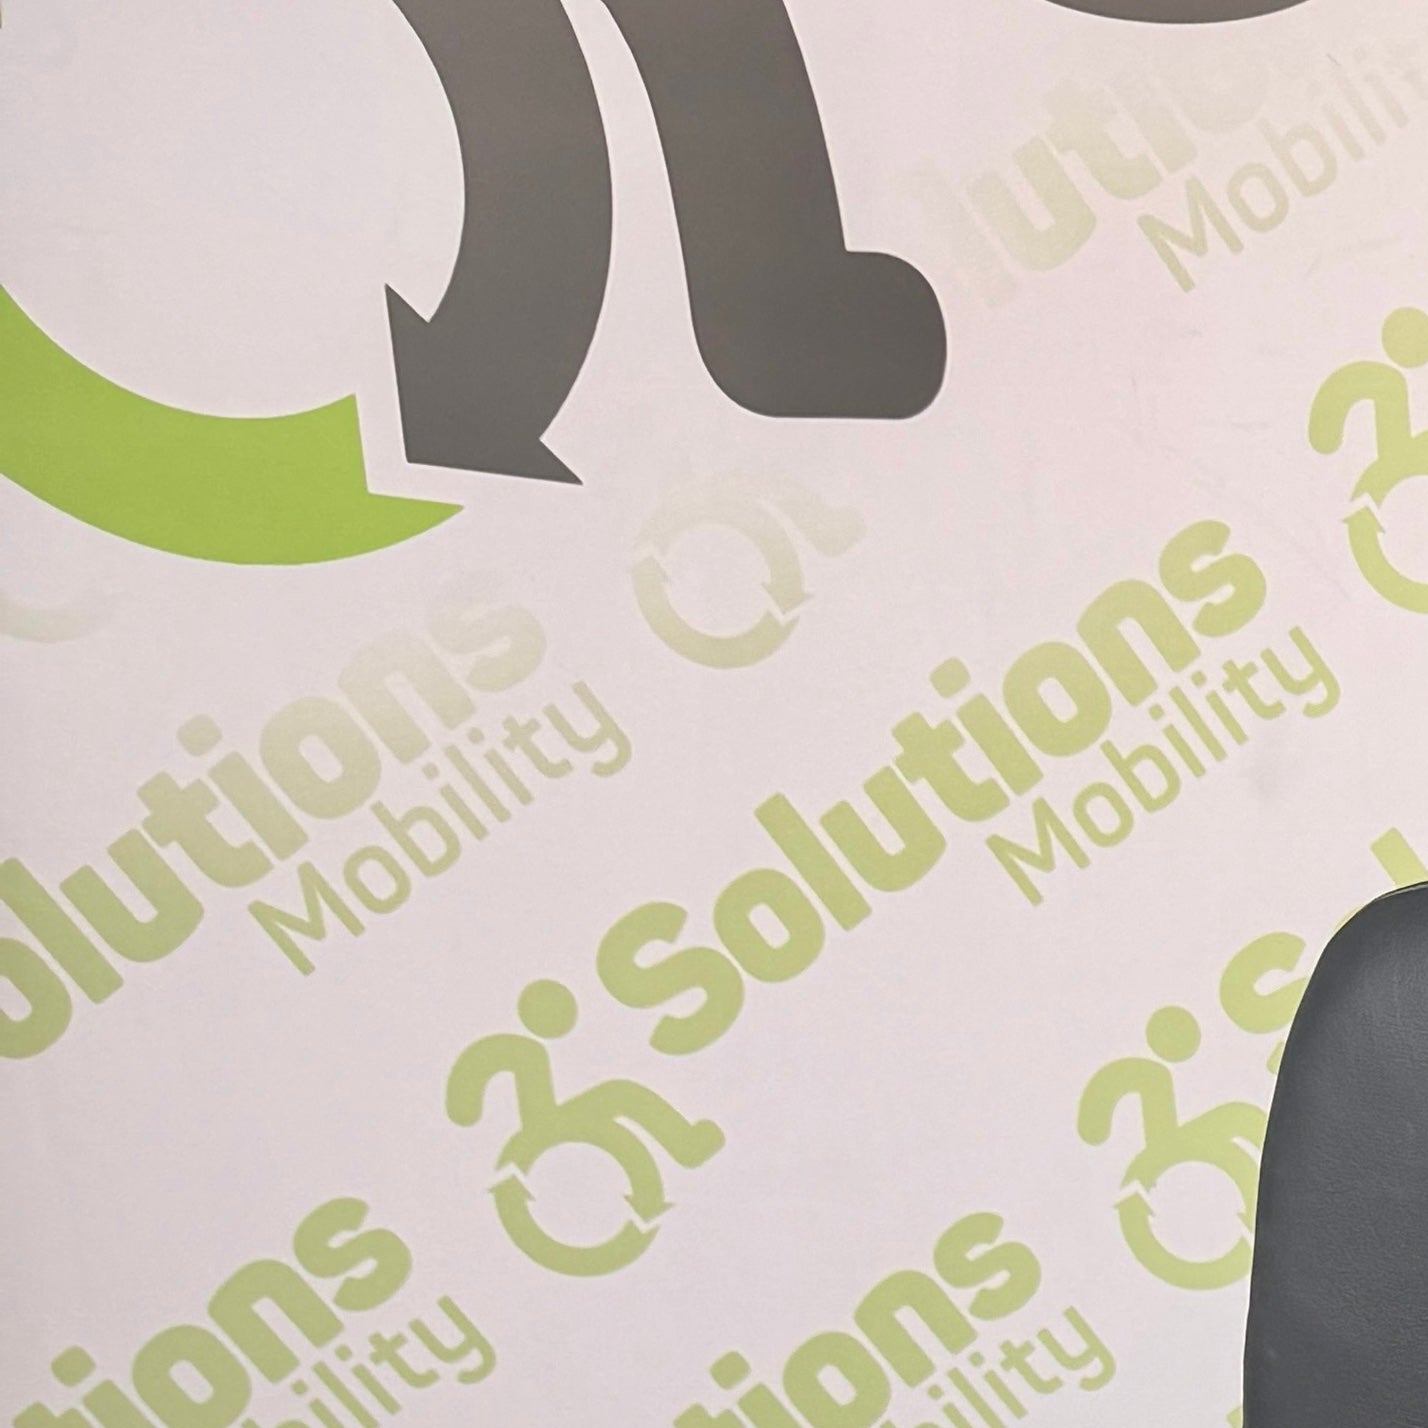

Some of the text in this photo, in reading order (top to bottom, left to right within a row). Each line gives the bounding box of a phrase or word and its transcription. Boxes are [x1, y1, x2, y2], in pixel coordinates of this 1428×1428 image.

[249, 703, 629, 974] Mobility
[595, 519, 1267, 1056] Solutions
[985, 627, 1340, 905] Mobility
